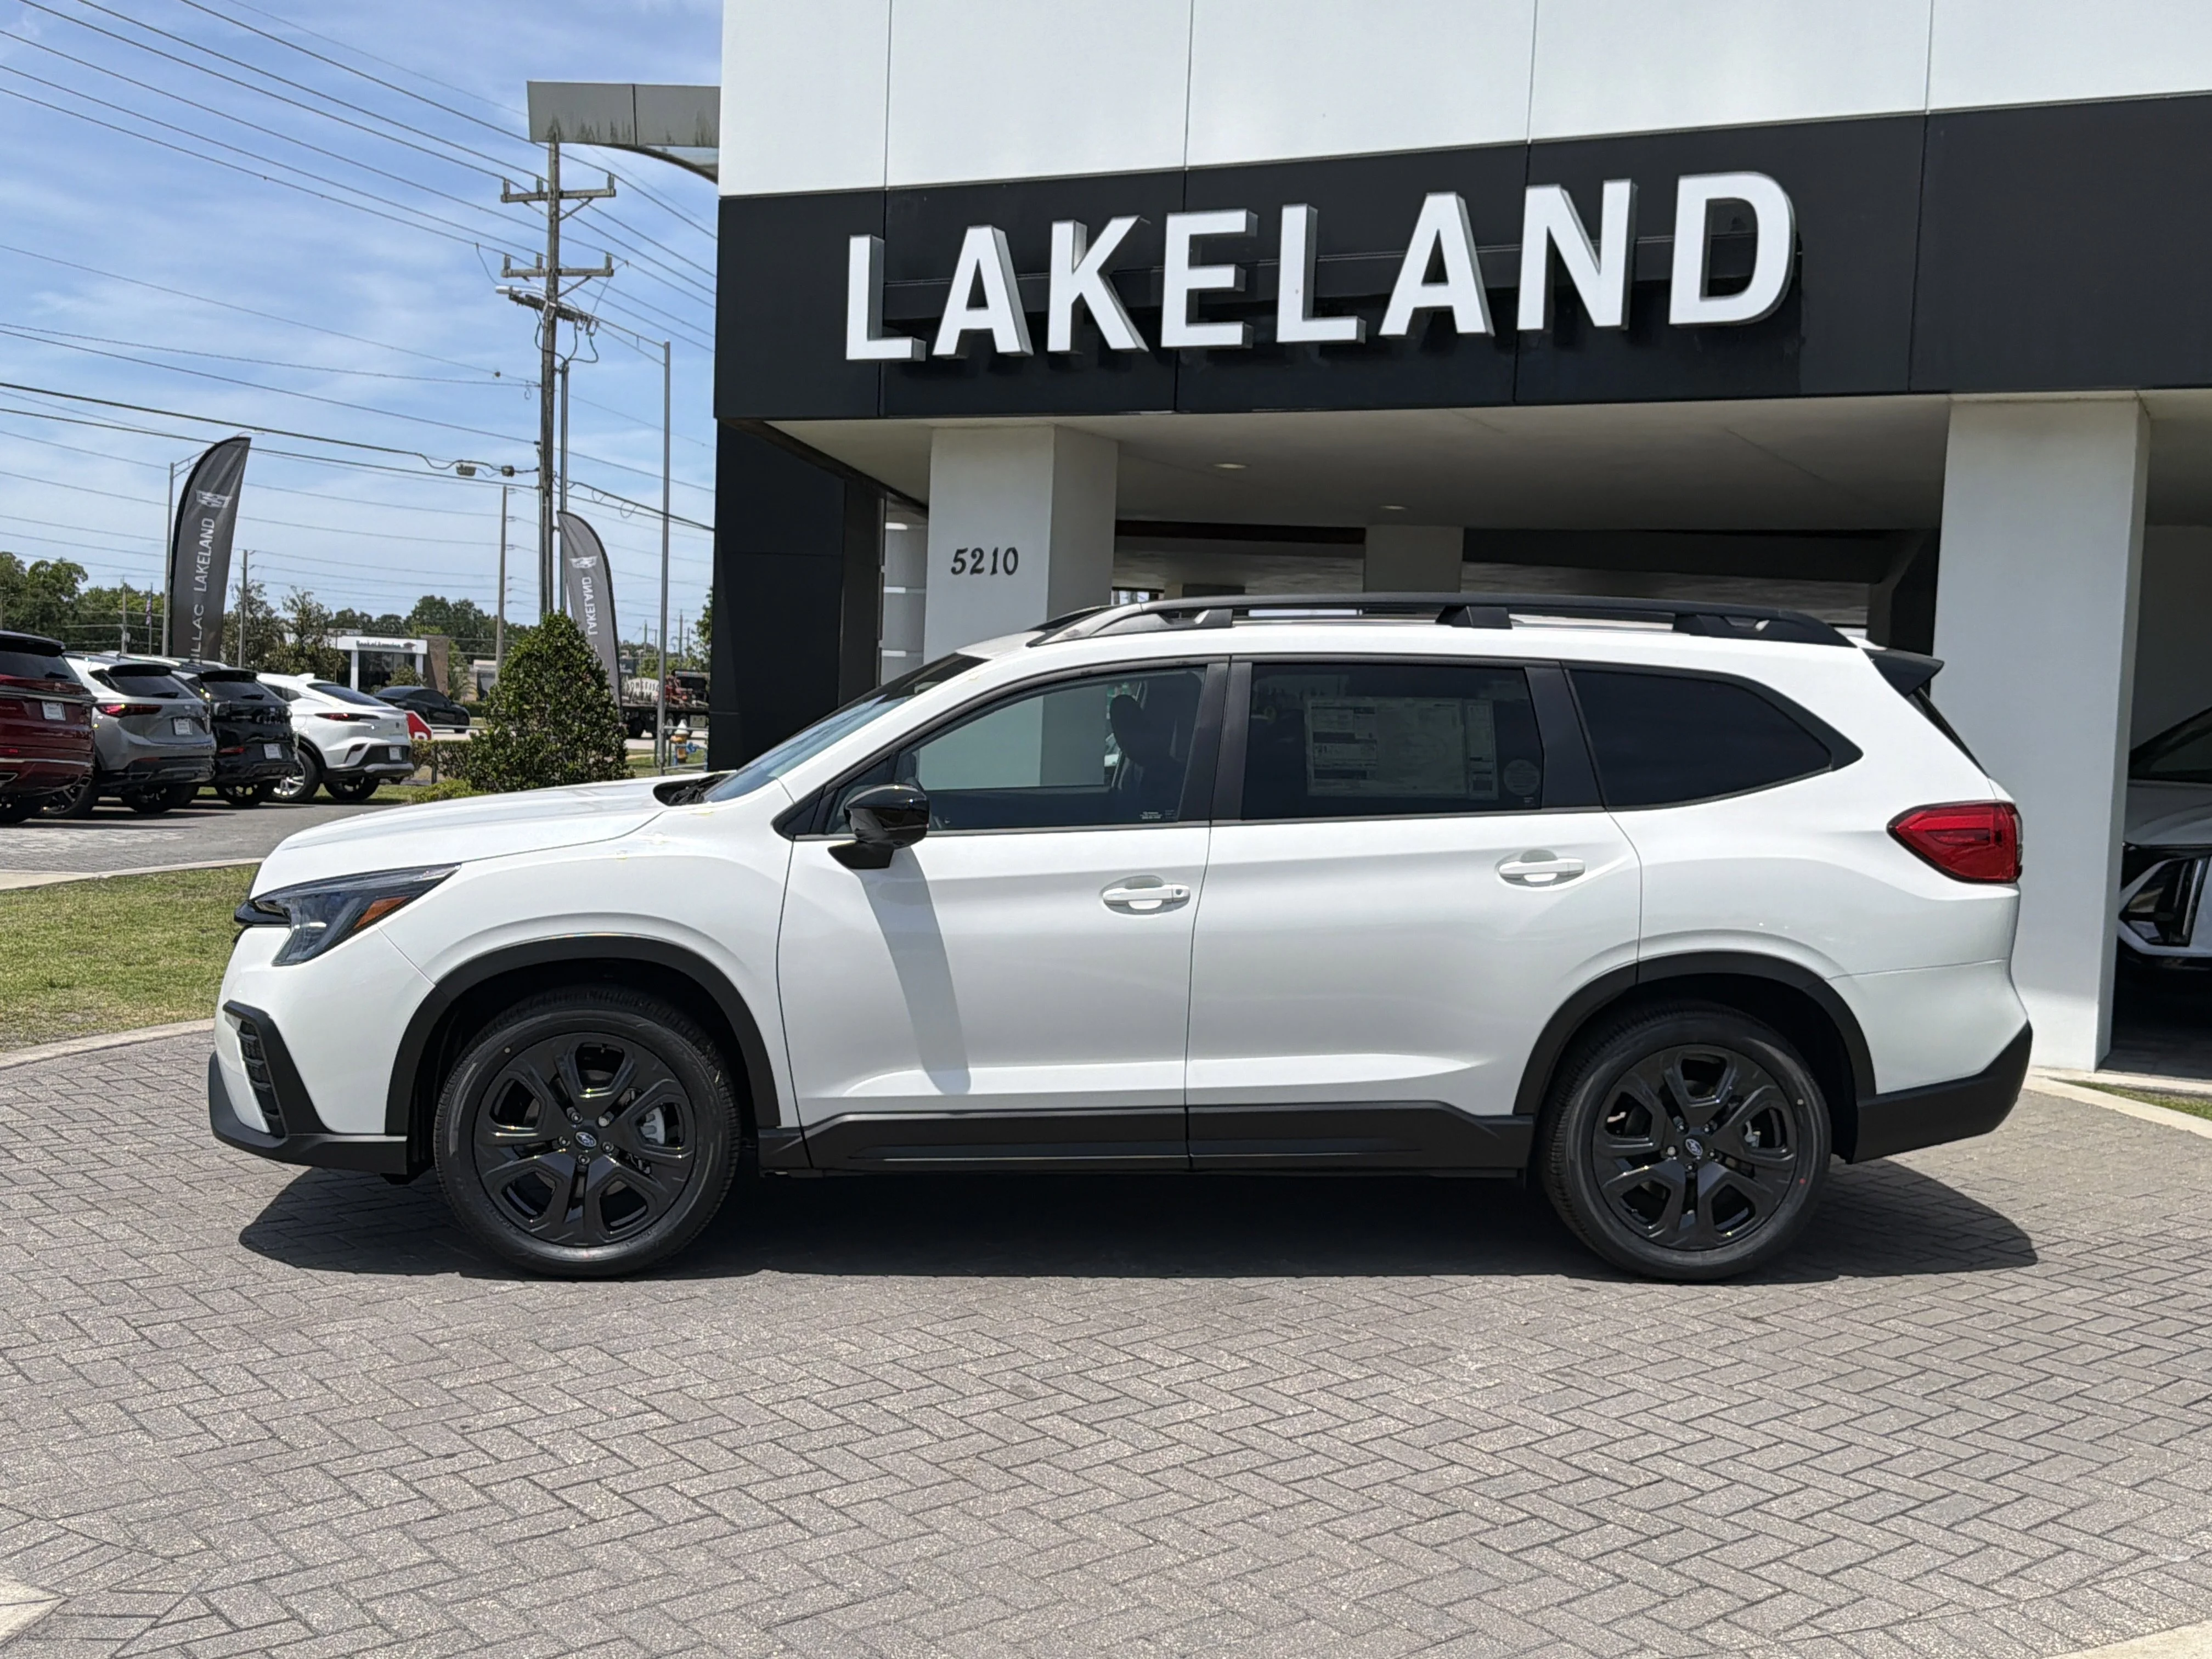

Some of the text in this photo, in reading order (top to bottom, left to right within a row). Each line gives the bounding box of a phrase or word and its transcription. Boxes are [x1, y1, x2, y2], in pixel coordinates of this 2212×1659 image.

[846, 171, 1796, 362] LAKELAND
[190, 517, 215, 658] ILLAC LAKELAND
[951, 546, 1019, 575] 5210
